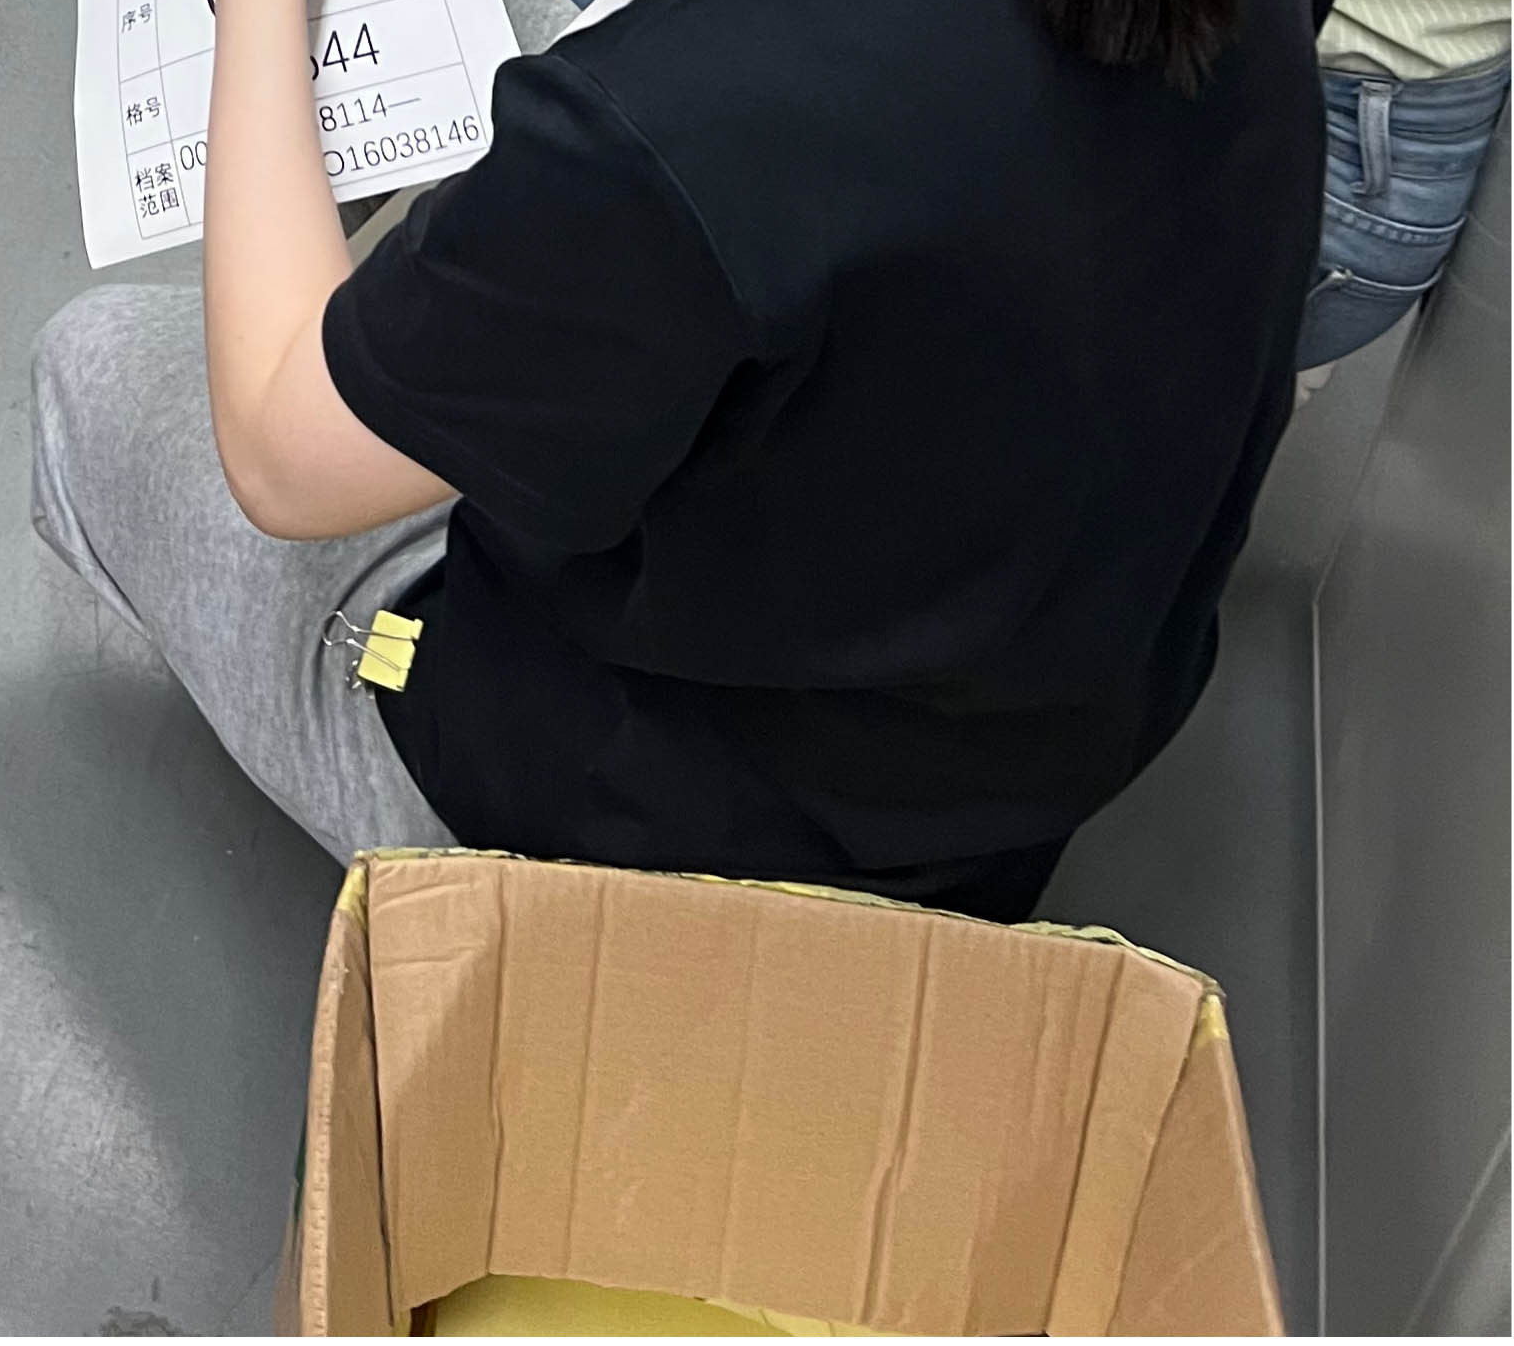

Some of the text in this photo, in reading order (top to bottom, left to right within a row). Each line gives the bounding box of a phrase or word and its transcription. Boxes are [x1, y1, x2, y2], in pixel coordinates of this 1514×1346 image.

[121, 2, 154, 35] 序号
[125, 96, 162, 127] 格号
[134, 161, 175, 193] 档案
[139, 187, 182, 219] 范围
